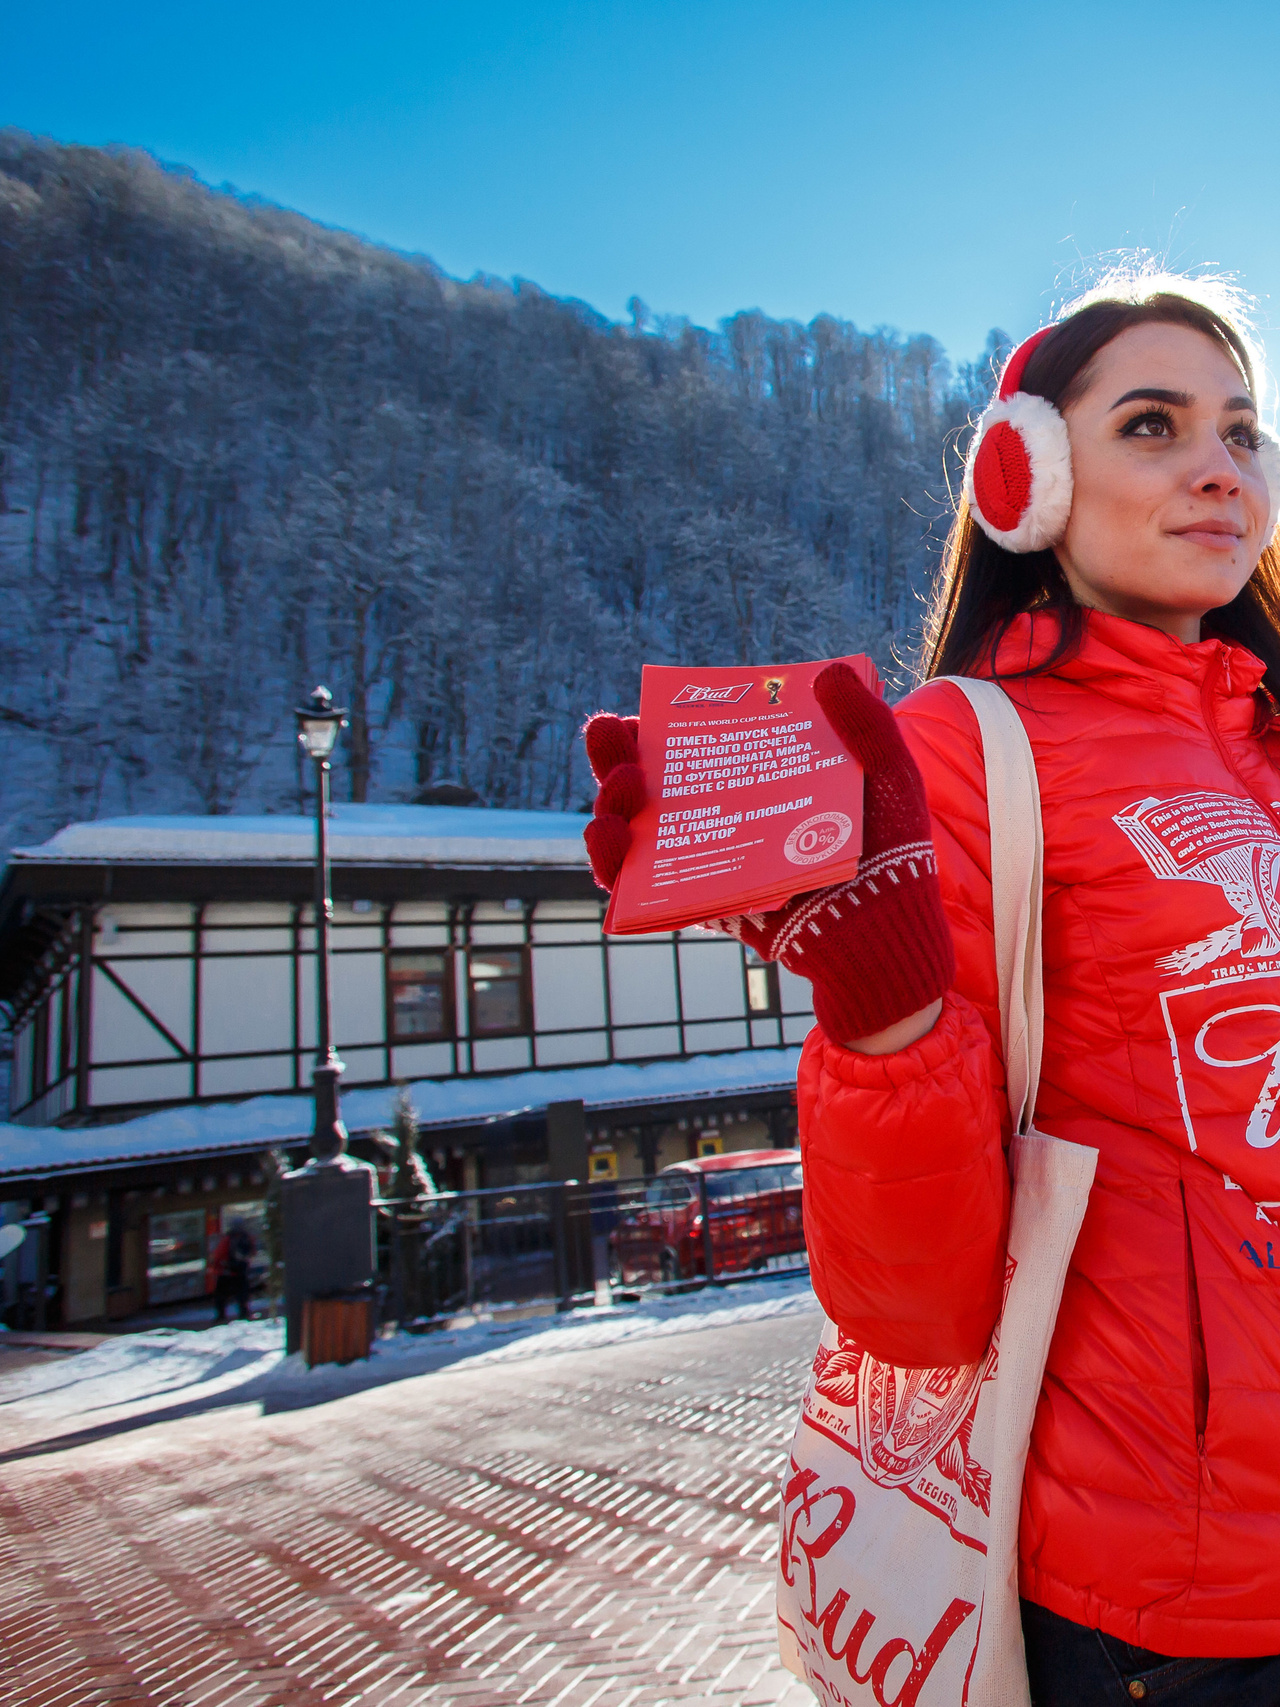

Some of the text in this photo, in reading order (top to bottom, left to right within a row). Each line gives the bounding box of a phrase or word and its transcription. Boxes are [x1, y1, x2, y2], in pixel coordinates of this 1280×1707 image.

[686, 686, 734, 701] Bud
[666, 720, 813, 748] ОТМЕТЬ ЗАПУСК ЧАСОВ
[667, 721, 688, 729] 2018
[688, 720, 707, 728] FIFA
[707, 717, 738, 727] WORLD
[739, 715, 758, 724] CUP
[663, 741, 812, 774] ДО ЧЕМПИОНАТА МИРА
[665, 734, 798, 760] ОБРАТНОГО ОТСЧЕТА
[661, 754, 848, 799] ВМЕСТЕ С BUD ALCOHOL FREE.
[662, 773, 683, 786] ПО
[685, 764, 750, 783] ФУТБОЛУ
[752, 757, 778, 774] FIFA
[657, 795, 813, 837] НА ГЛАВНОЙ ПЛОЩАДИ
[658, 805, 721, 824] СЕГОДНЯ
[1150, 808, 1172, 828] This
[1172, 809, 1181, 817] is
[1180, 803, 1195, 814] the
[1194, 800, 1224, 811] famous
[1161, 822, 1180, 837] any
[1180, 812, 1203, 826] other
[1202, 809, 1230, 819] brewer
[1207, 817, 1252, 830] Beechwood
[656, 826, 737, 850] РОЗА ХУТОР
[786, 813, 850, 846] БЕЗАЛКОГОЛЬНАЯ
[1178, 842, 1197, 859] and
[1196, 838, 1204, 847] a
[1203, 828, 1249, 845] drinkability
[791, 839, 844, 864] ПРОДУКЦИЯ
[886, 1381, 896, 1419] AFRICA
[874, 1444, 909, 1472] AMERICA
[781, 1468, 977, 1707] Bud
